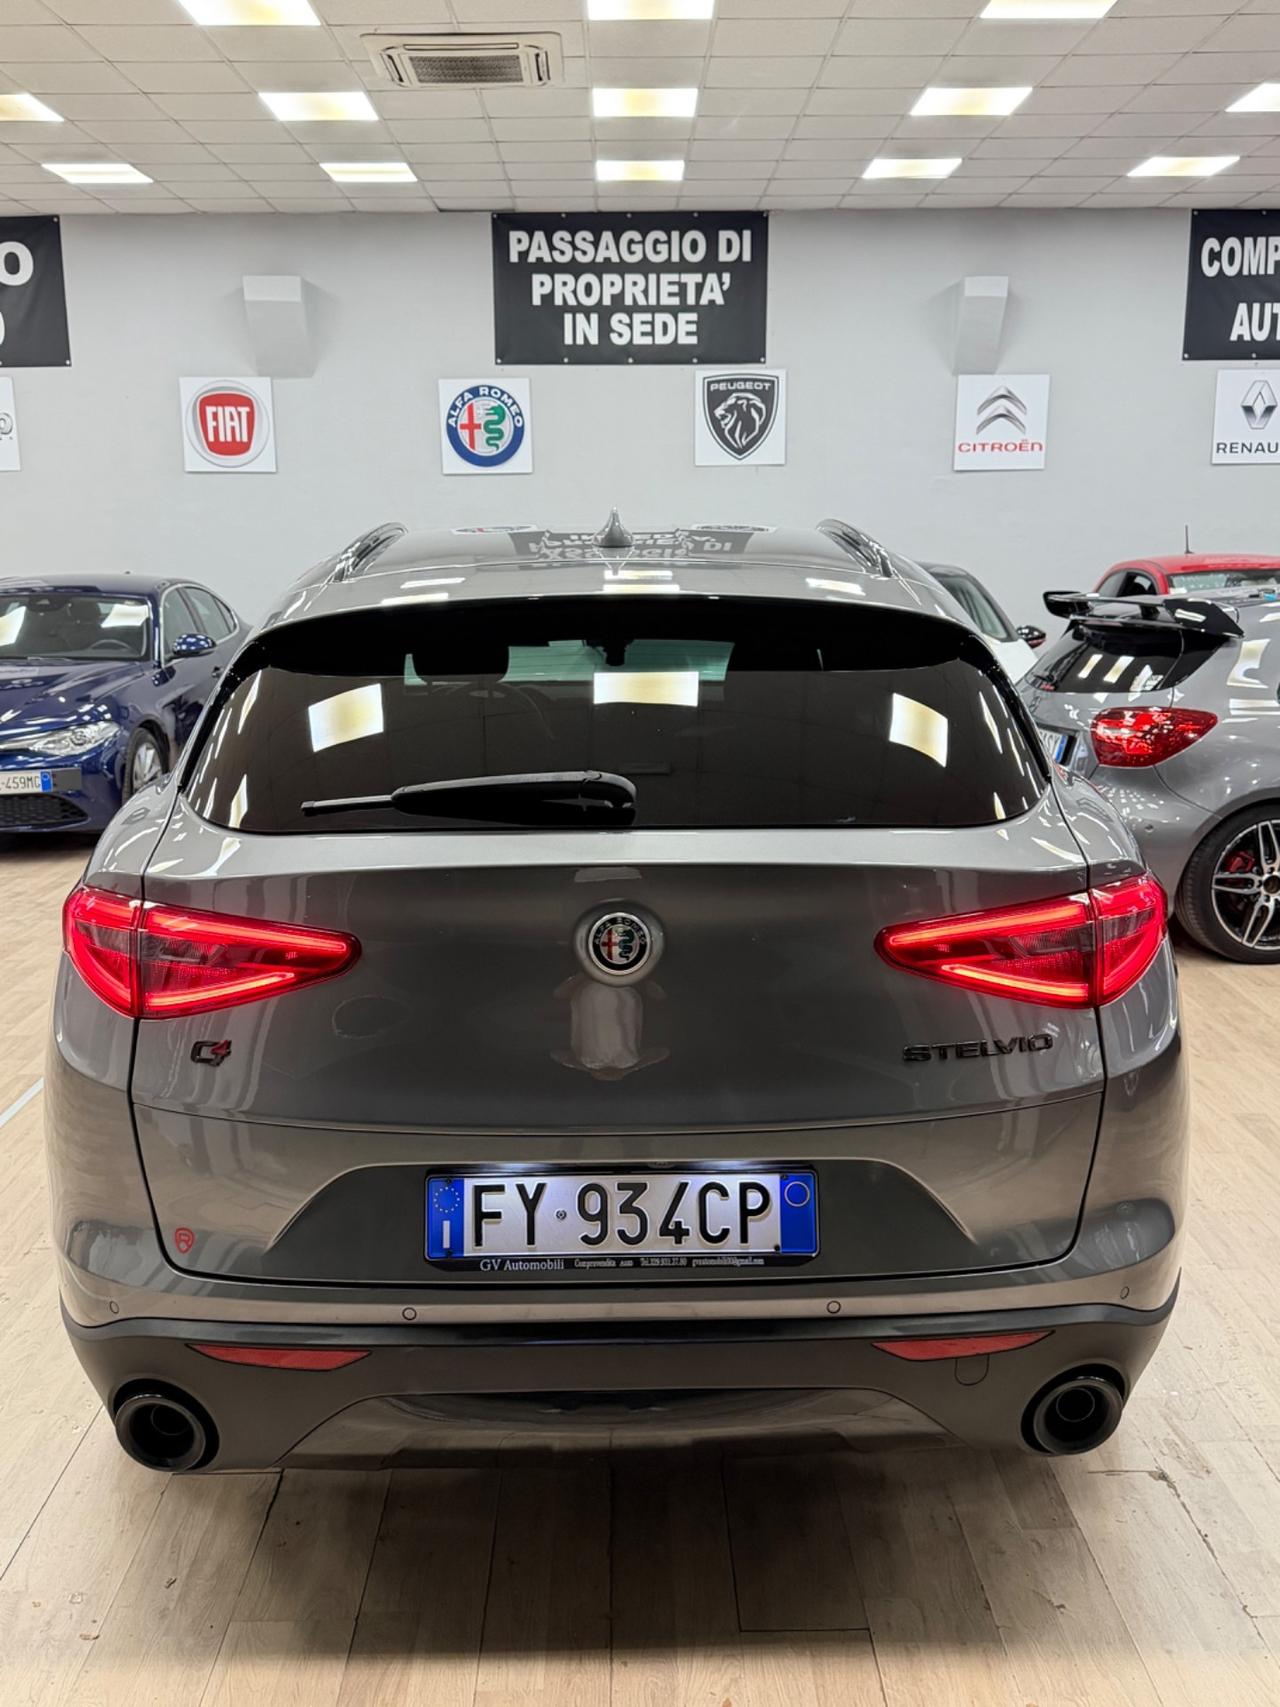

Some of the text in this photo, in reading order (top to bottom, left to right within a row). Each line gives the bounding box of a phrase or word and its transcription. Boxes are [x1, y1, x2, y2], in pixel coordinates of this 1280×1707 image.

[508, 229, 752, 264] PASSAGGIO DI
[1200, 236, 1280, 278] COMP
[563, 312, 699, 346] IN SEDE
[709, 380, 772, 393] PEUGEOT
[207, 405, 251, 443] FIAT
[447, 386, 524, 428] ALFA ROMEO
[1216, 441, 1280, 454] RENAU
[190, 1039, 233, 1068] Q4
[902, 1033, 1054, 1062] STELVIO
[472, 1182, 548, 1248] FY
[576, 1181, 773, 1247] 934CP
[480, 1258, 501, 1272] GV
[504, 1259, 564, 1271] Automobili
